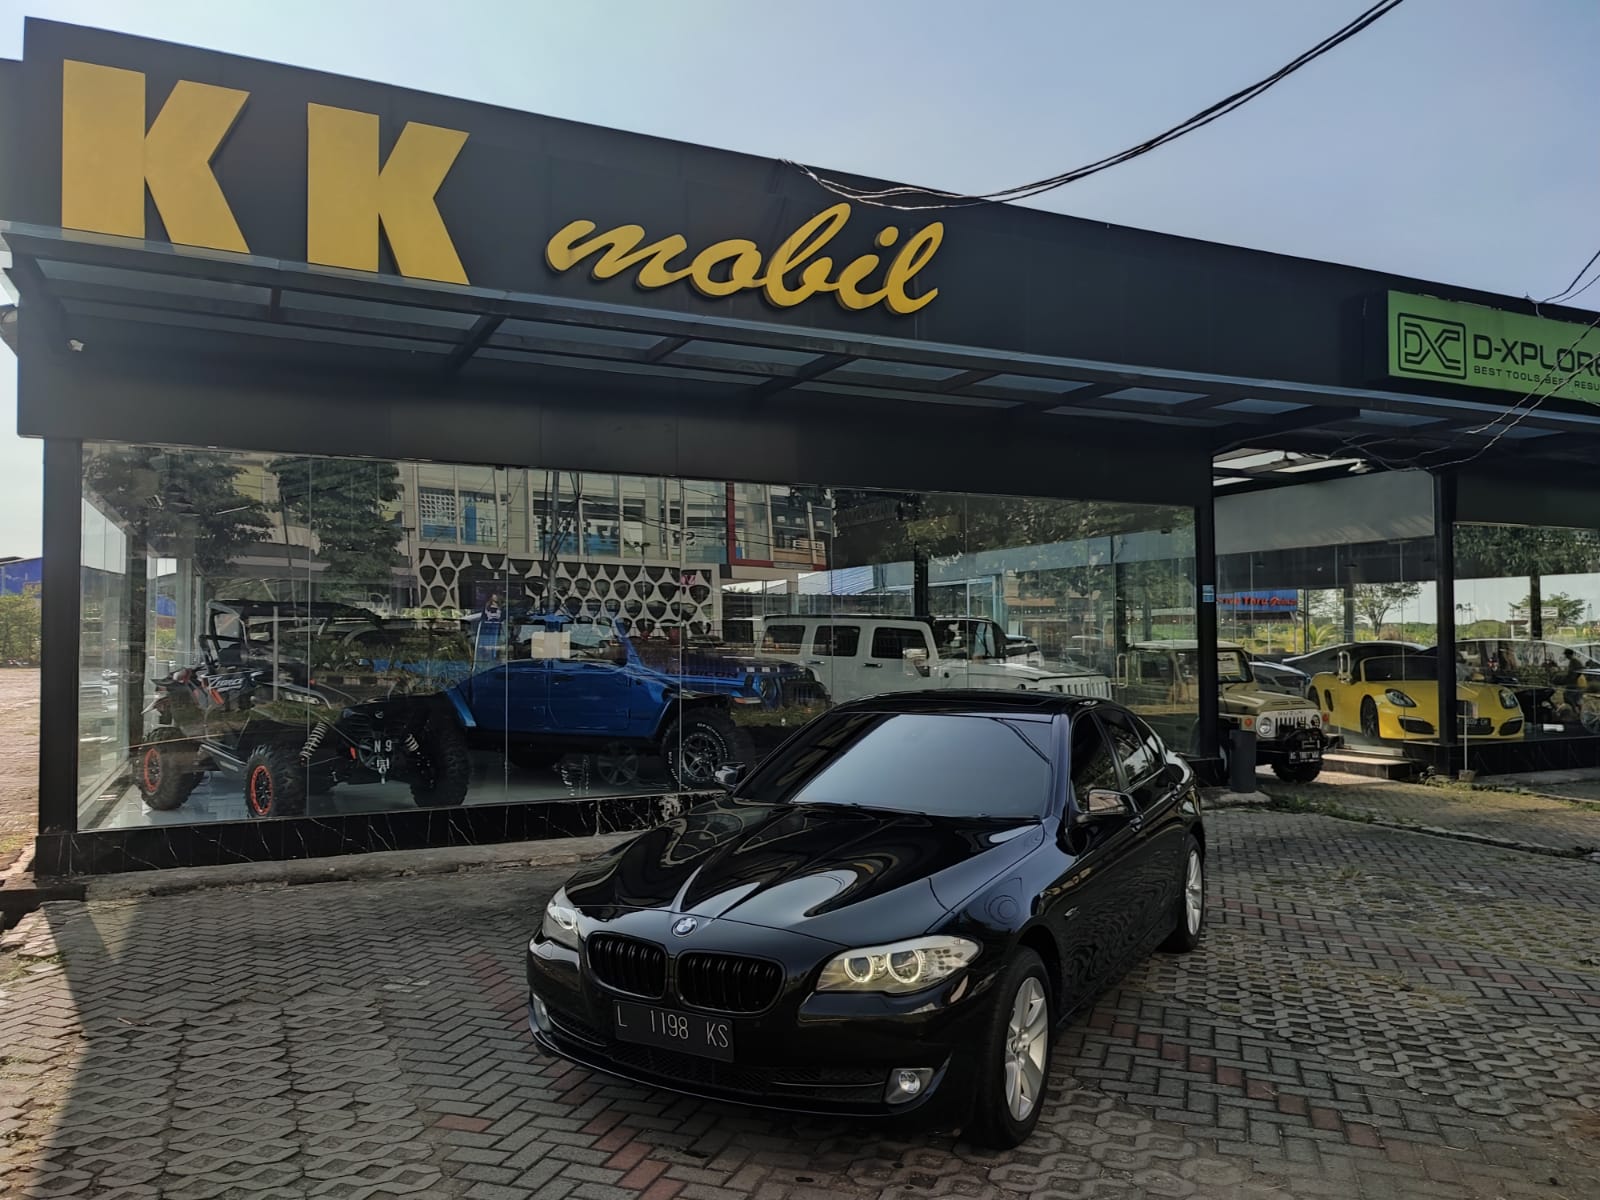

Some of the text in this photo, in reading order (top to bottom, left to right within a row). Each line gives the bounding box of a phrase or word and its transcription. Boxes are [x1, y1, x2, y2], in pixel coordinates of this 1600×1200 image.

[546, 202, 945, 315] mobil
[1473, 365, 1502, 377] BEST
[1506, 370, 1541, 383] TOOLS
[374, 739, 393, 753] N 9
[616, 1004, 729, 1049] L 1198 KS
